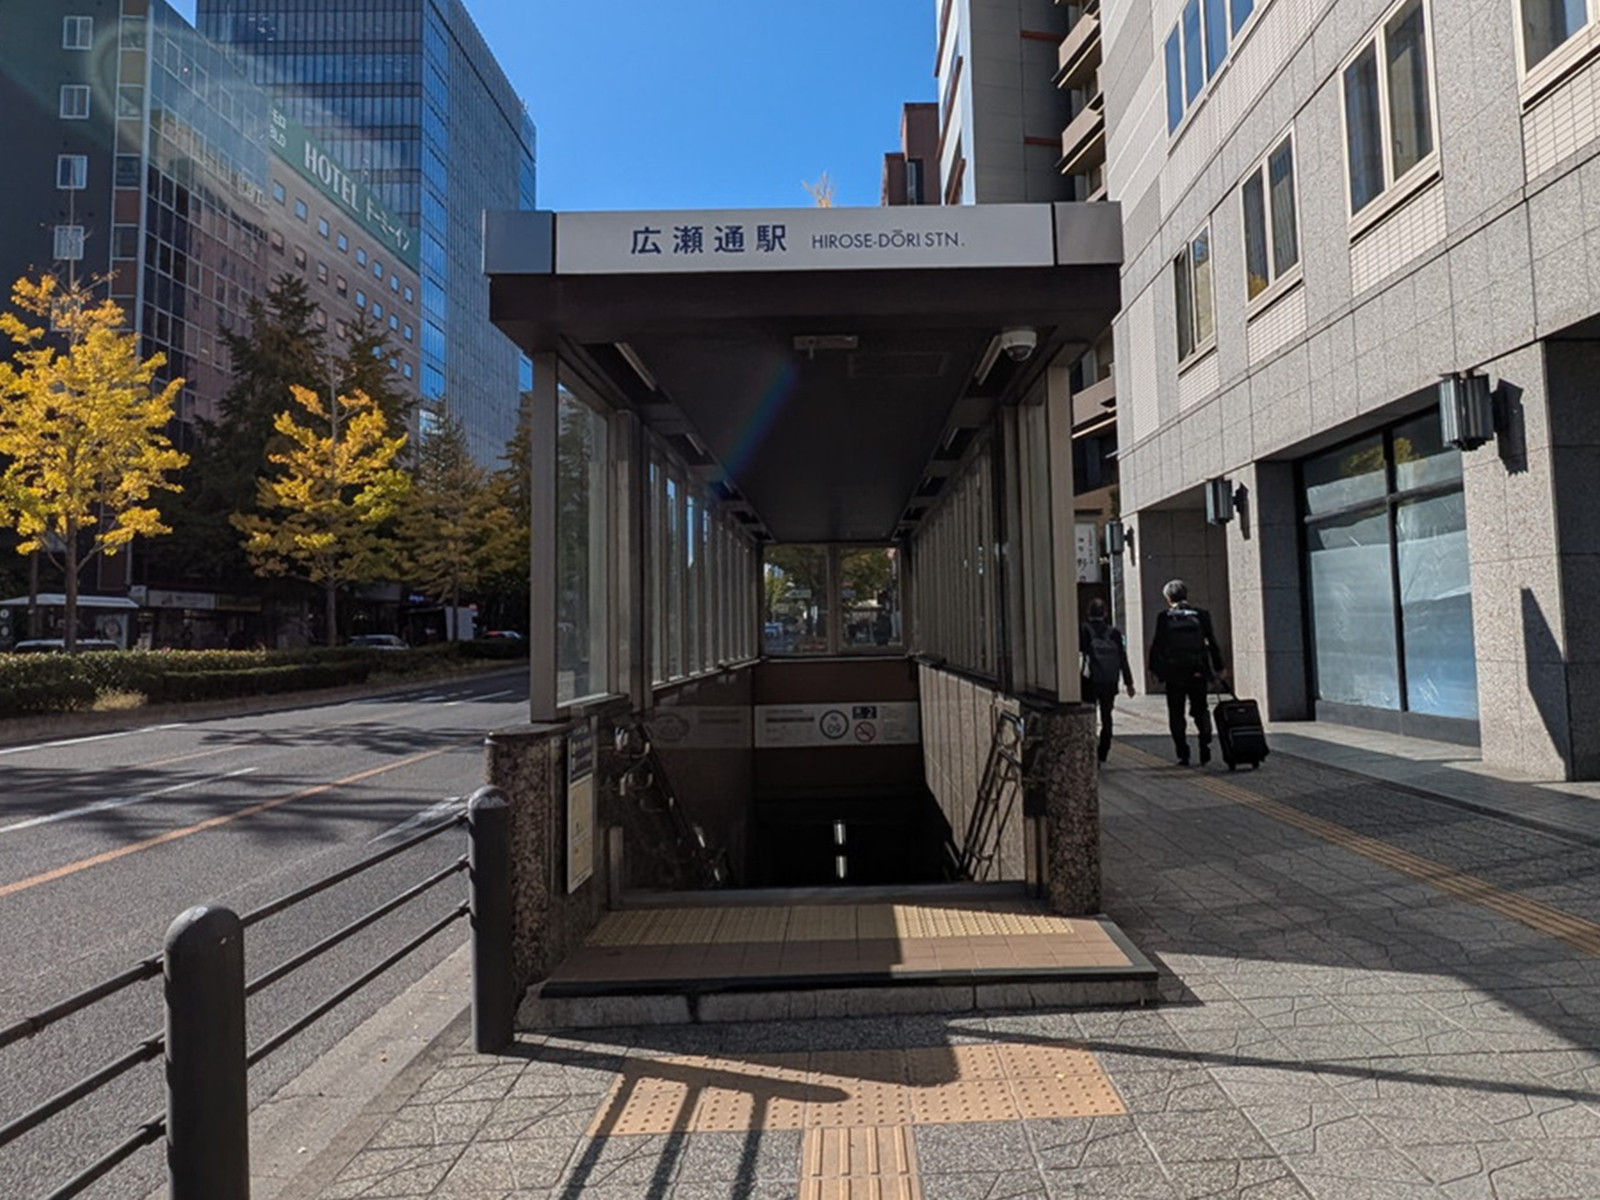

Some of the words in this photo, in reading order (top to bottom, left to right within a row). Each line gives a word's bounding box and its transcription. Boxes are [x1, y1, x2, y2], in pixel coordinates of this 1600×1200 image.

[304, 140, 359, 213] HOTEL
[365, 197, 411, 252] ドーミーイン
[631, 225, 788, 255] 広瀬通駅
[811, 229, 921, 249] HIROSE-DŌRI
[924, 231, 966, 247] STN.
